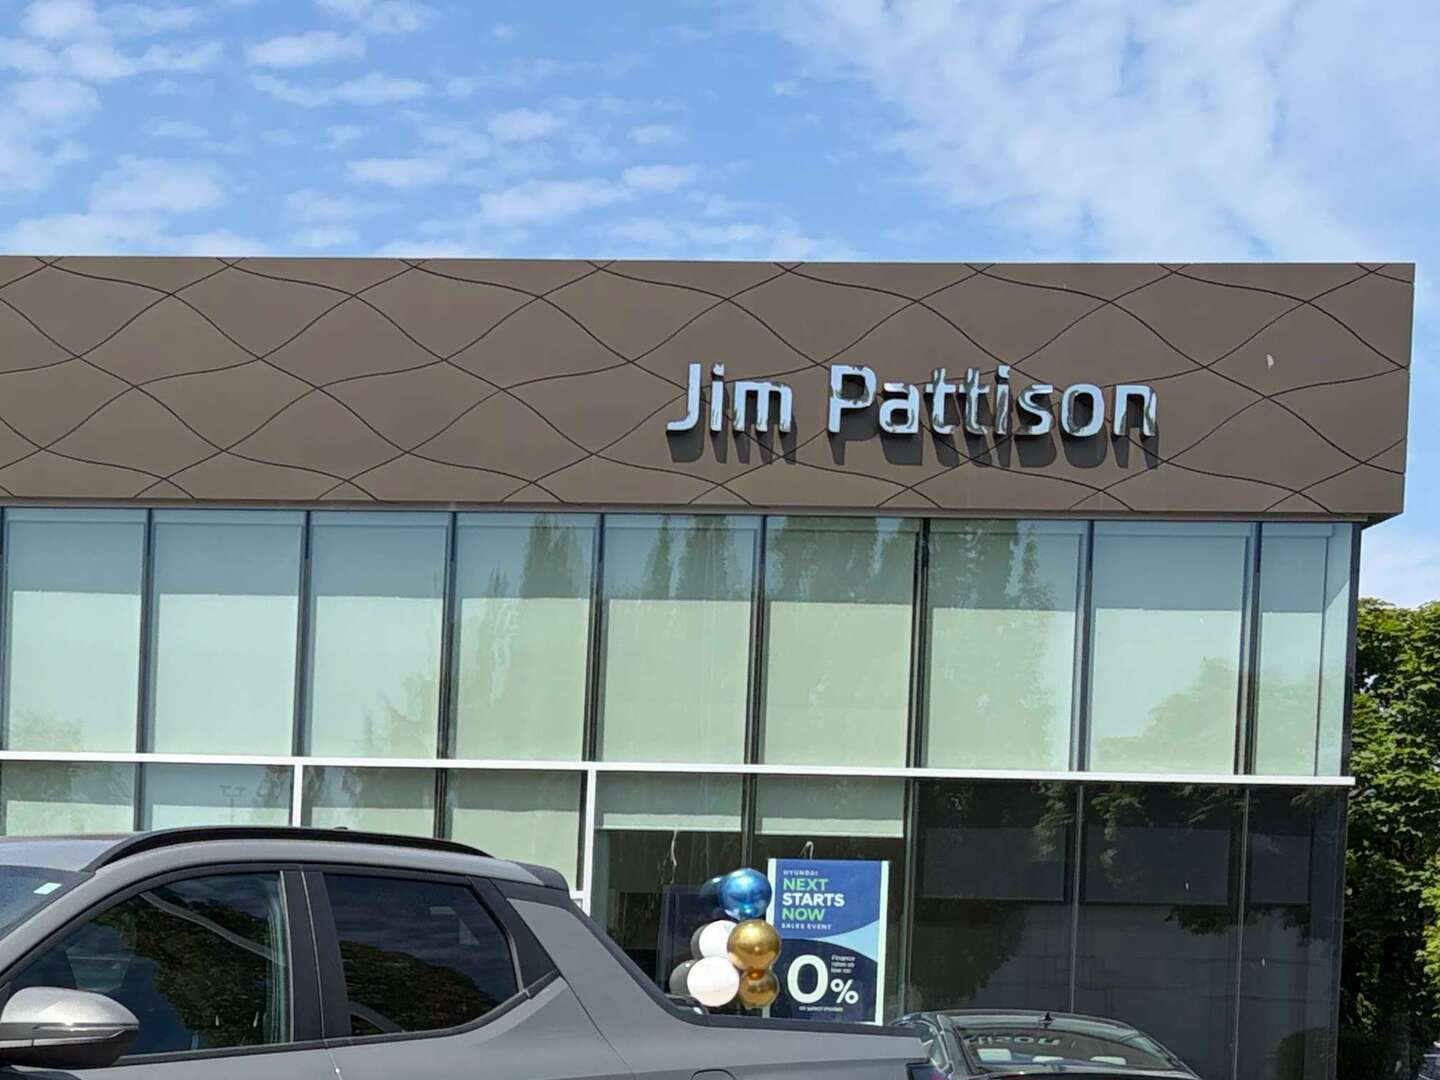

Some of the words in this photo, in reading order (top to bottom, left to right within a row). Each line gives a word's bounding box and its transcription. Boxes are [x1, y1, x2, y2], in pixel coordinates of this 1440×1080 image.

[666, 362, 793, 433] Jim
[827, 364, 1159, 438] Pattison
[783, 878, 829, 891] NEXT
[781, 892, 845, 908] STARTS
[782, 908, 826, 920] NOW
